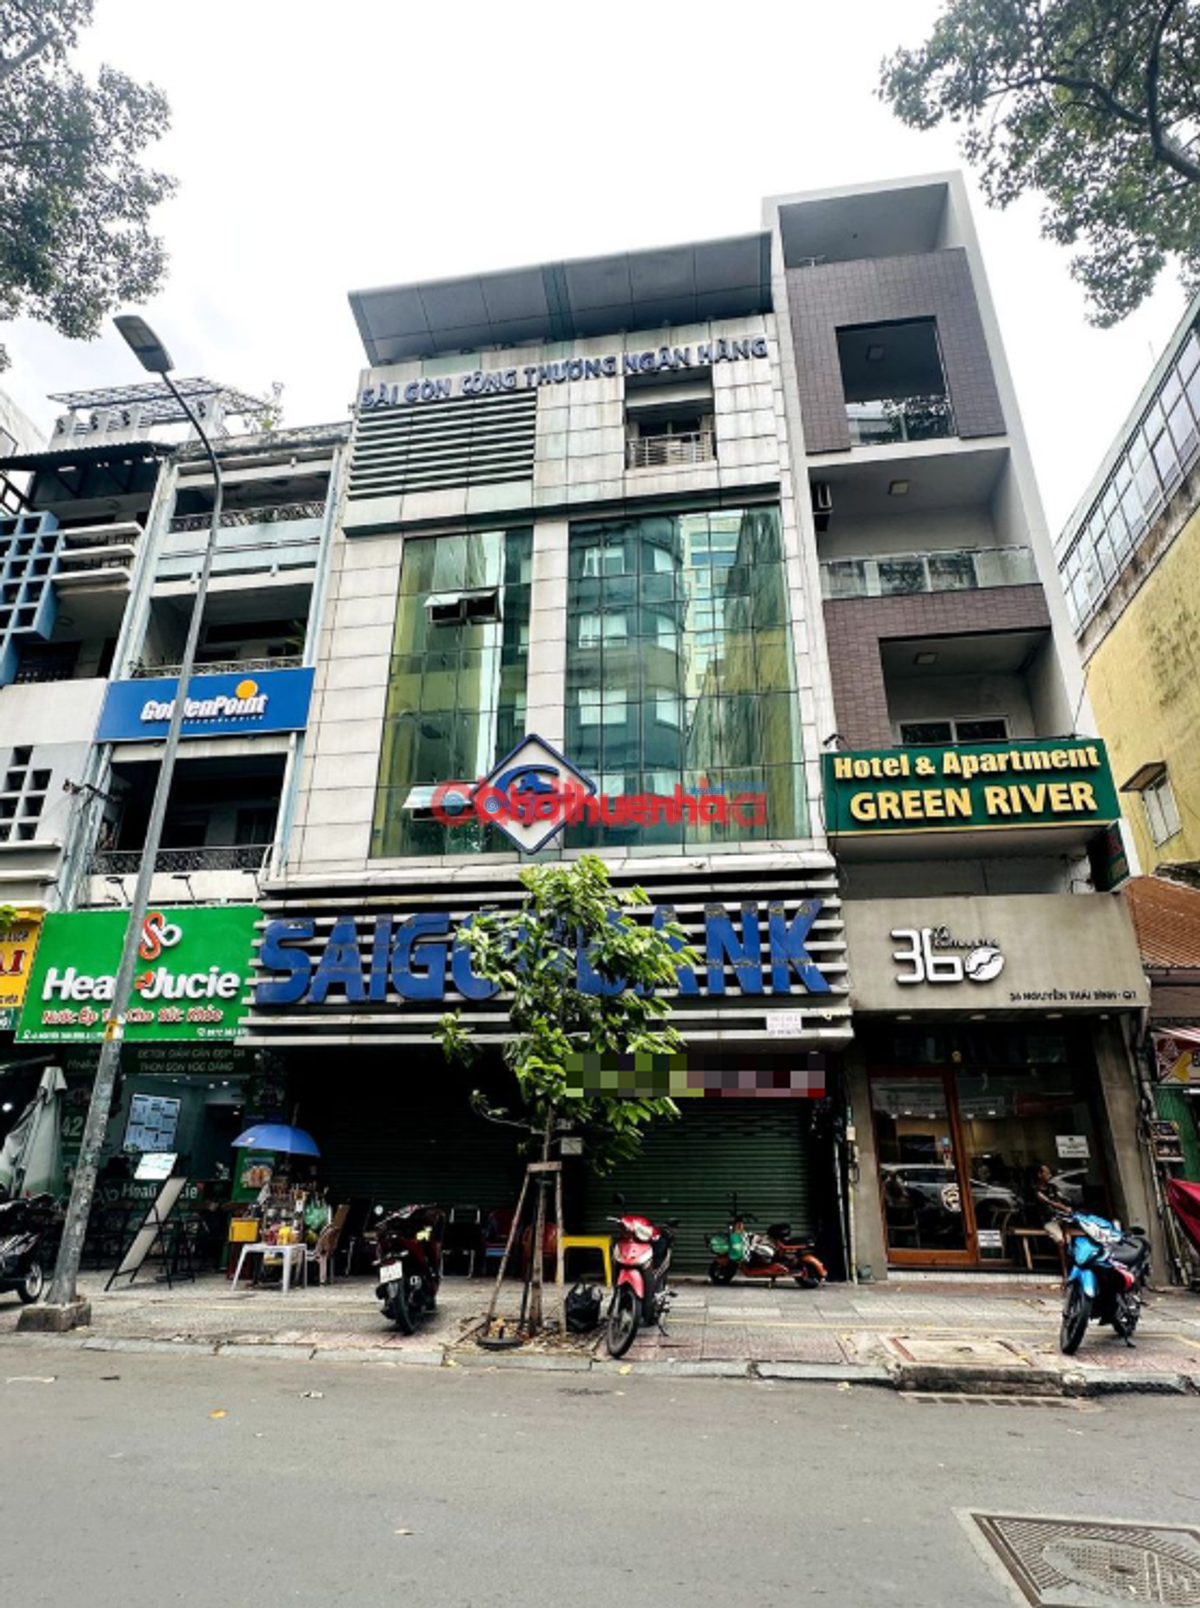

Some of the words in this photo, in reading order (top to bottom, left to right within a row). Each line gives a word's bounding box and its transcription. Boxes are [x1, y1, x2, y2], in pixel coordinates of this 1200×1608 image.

[404, 378, 452, 404] GÒN
[460, 369, 517, 395] CÔNG
[524, 356, 616, 388] THƯƠNG
[622, 345, 690, 375] NGÂN
[697, 337, 768, 365] HÀNG
[834, 753, 910, 779] Hotel
[915, 754, 936, 776] &
[943, 745, 1101, 780] Apartment
[850, 787, 974, 821] GREEN
[984, 781, 1098, 816] RIVER
[140, 965, 241, 1000] Jucie
[61, 1114, 84, 1137] 42
